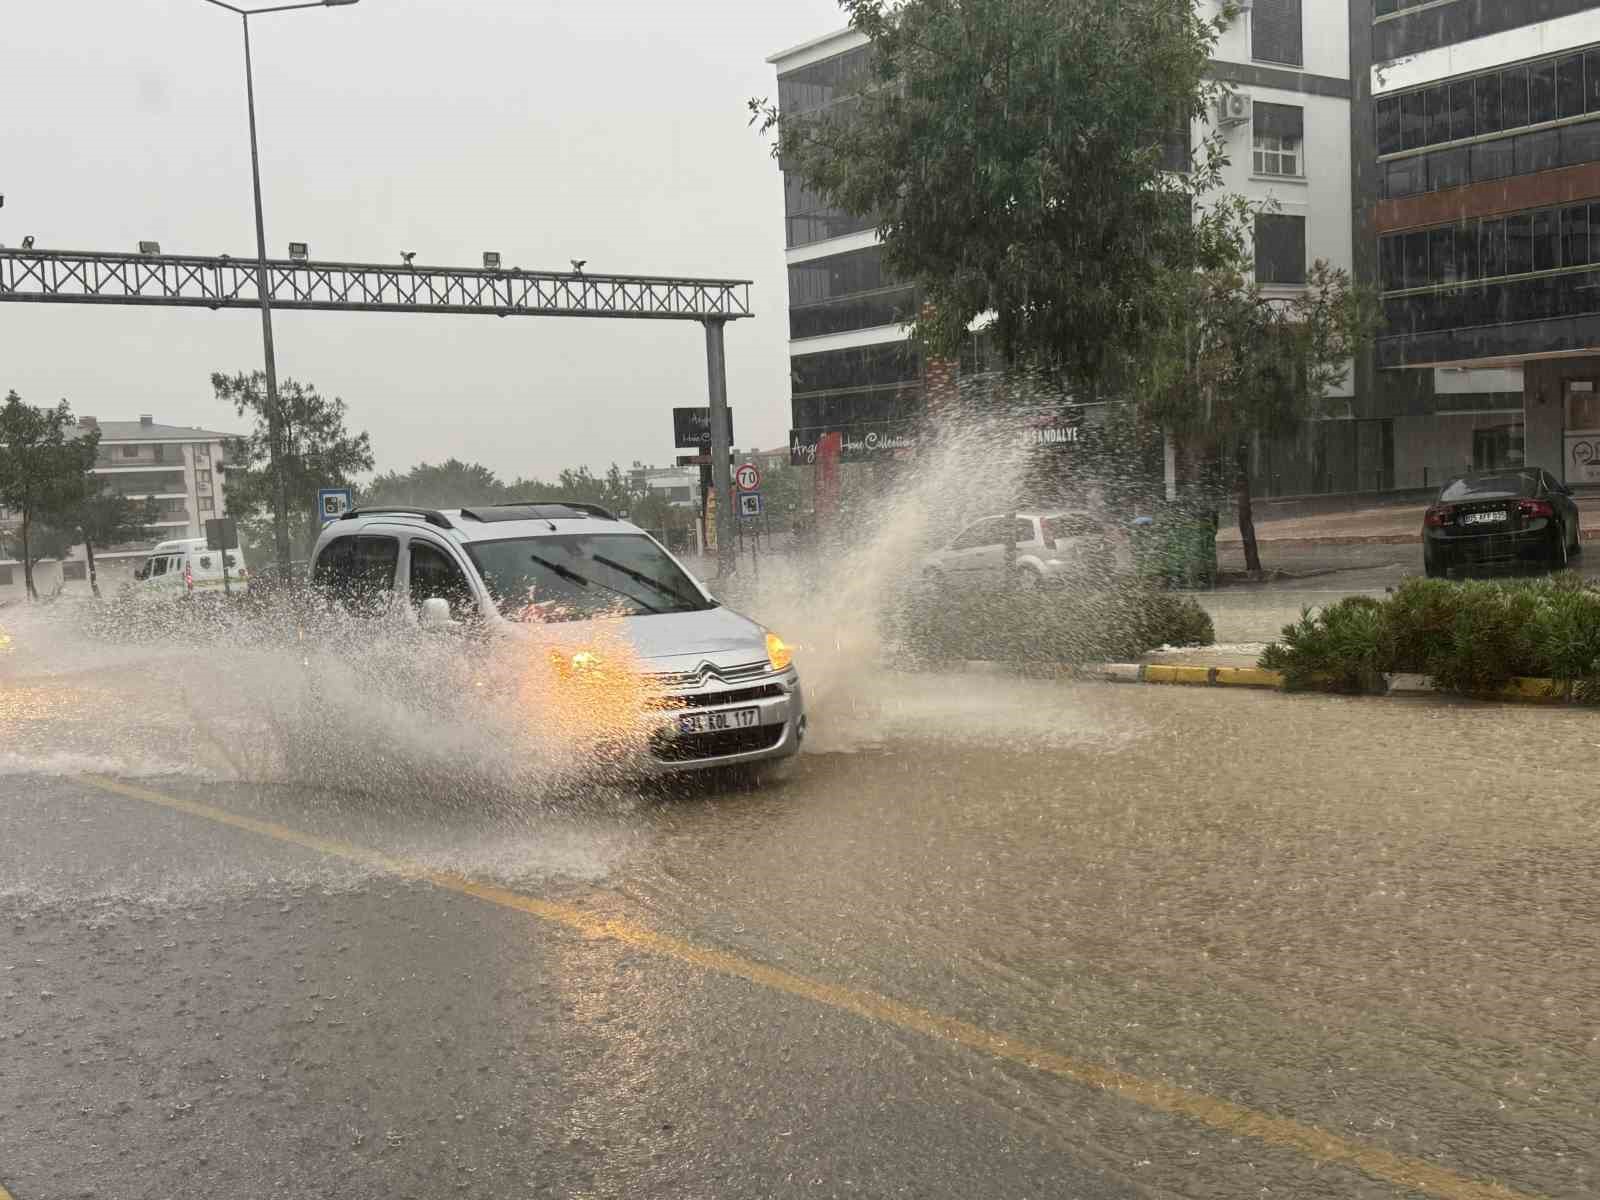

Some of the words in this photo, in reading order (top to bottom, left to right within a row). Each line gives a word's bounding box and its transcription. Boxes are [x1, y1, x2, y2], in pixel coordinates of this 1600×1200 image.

[1031, 427, 1079, 444] SANDALYE
[740, 472, 756, 484] 70
[735, 710, 755, 727] 117
